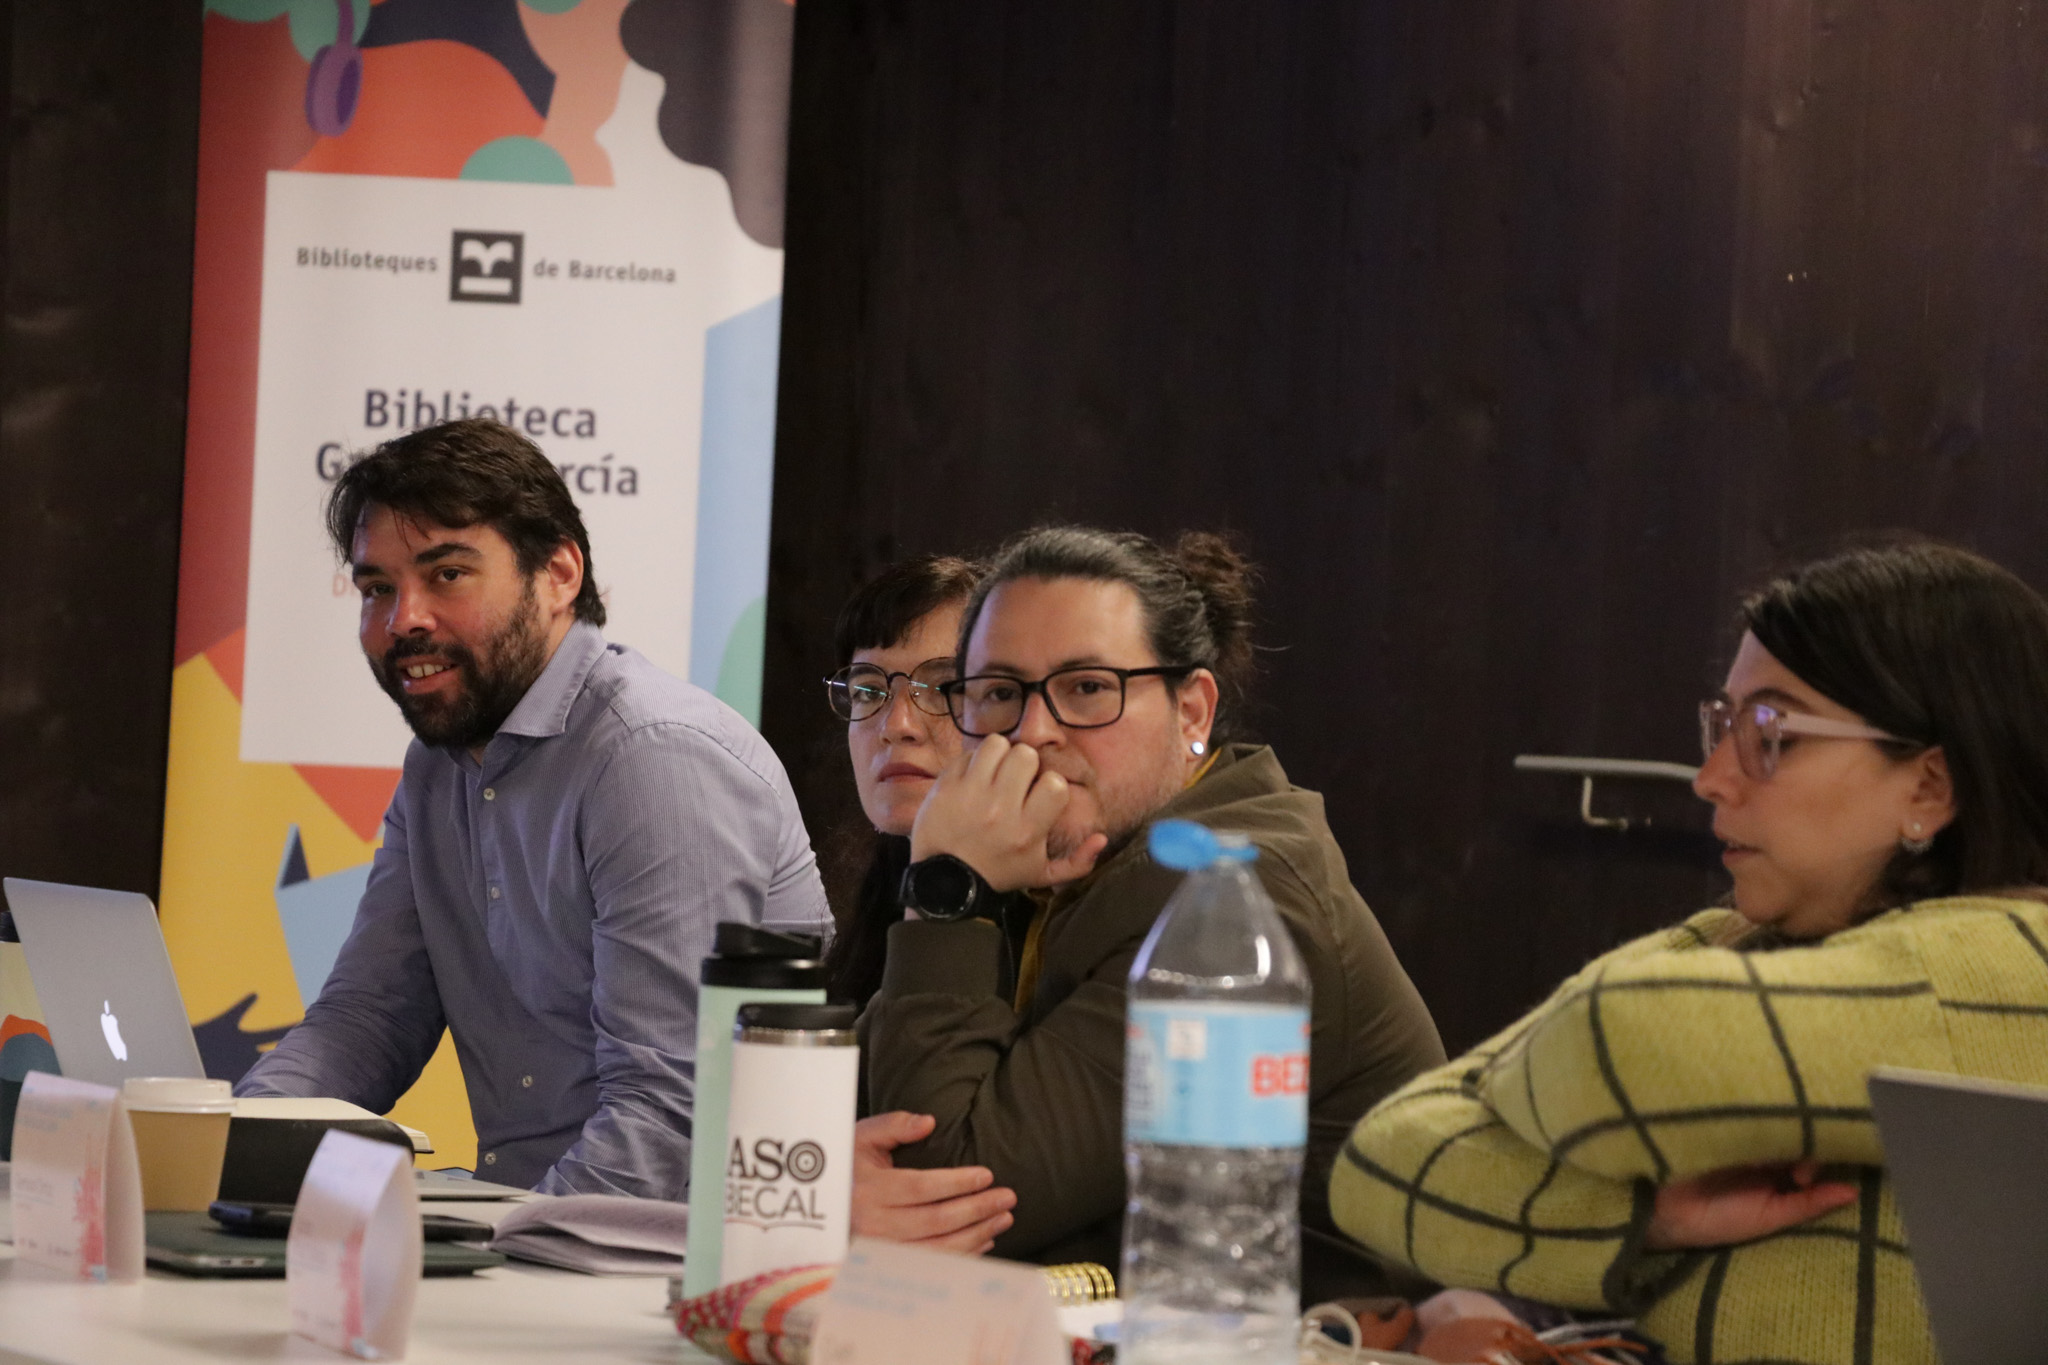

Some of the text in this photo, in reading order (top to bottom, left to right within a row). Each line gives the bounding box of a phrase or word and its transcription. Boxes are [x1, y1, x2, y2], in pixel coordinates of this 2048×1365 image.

[296, 246, 677, 283] Biblioteques de Barcelona
[560, 453, 638, 495] rcía
[727, 1137, 826, 1183] ASO
[726, 1182, 826, 1220] BECAL
